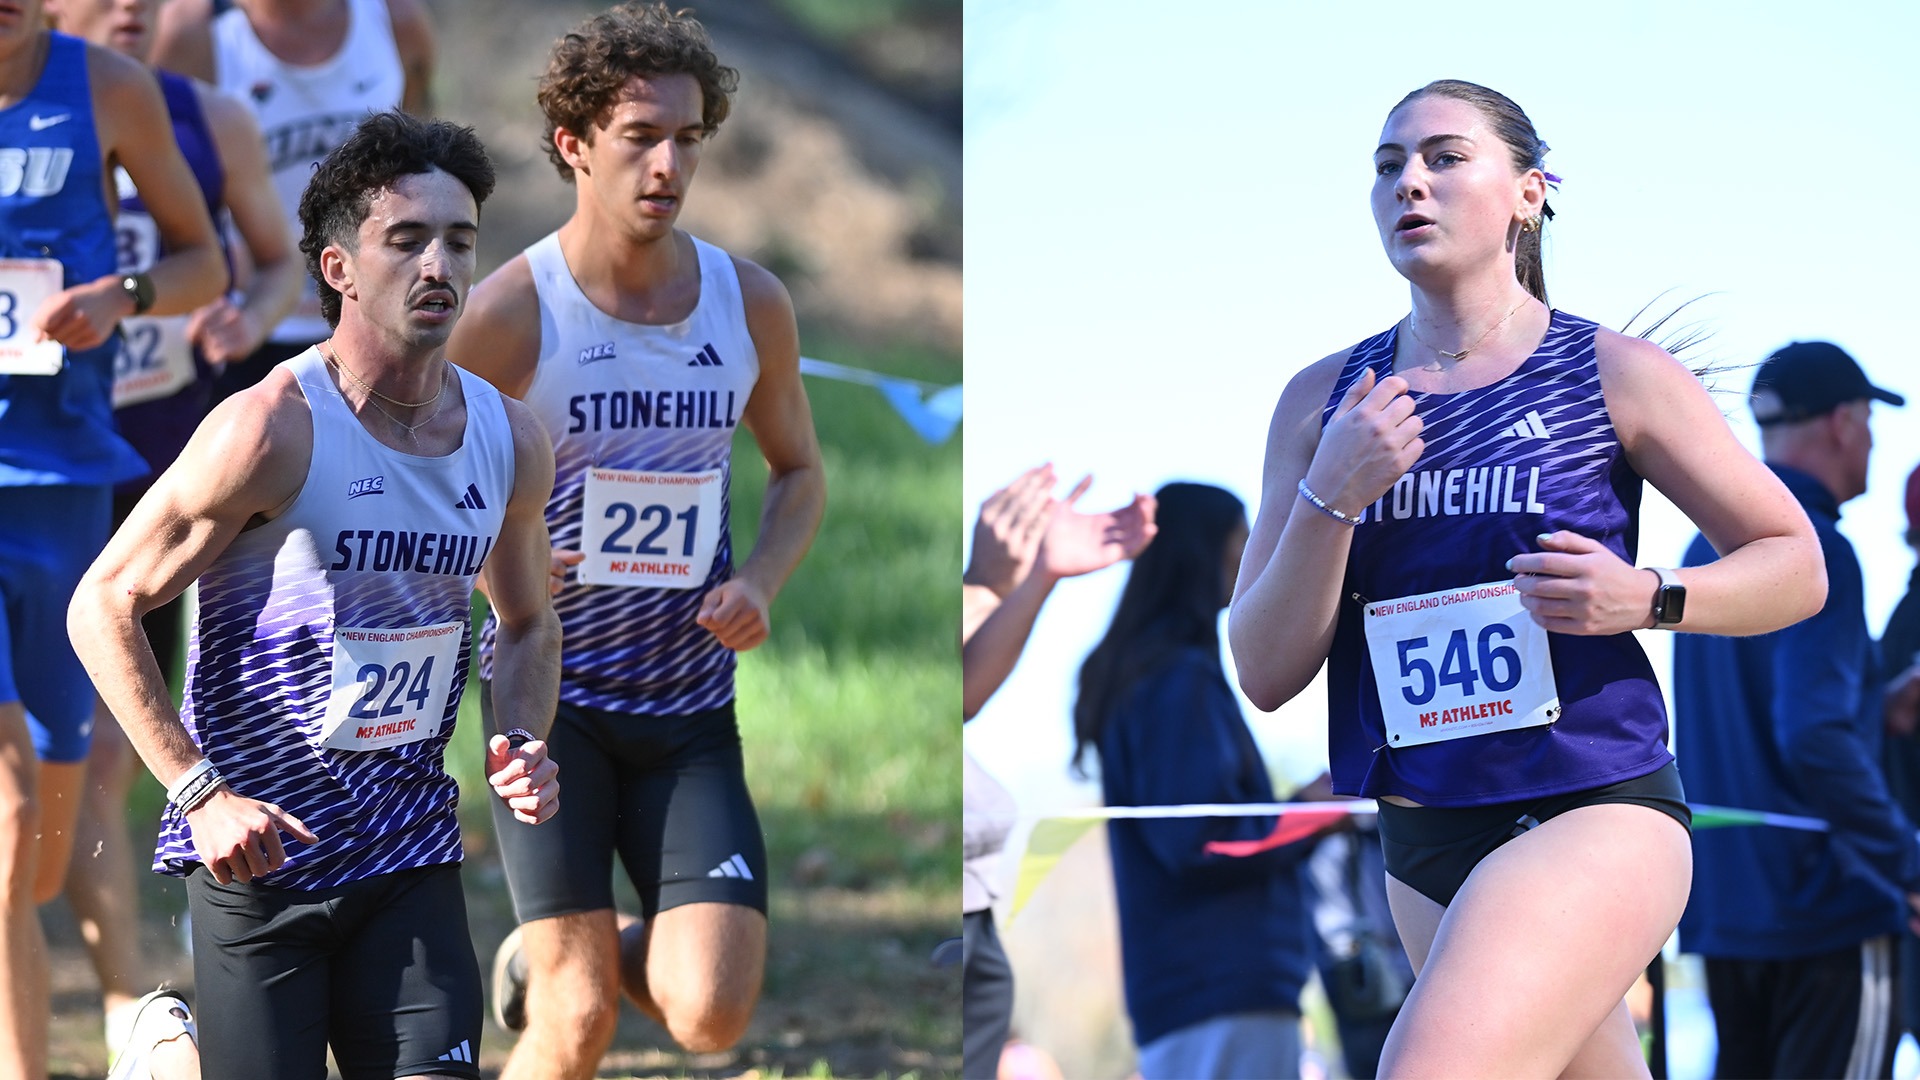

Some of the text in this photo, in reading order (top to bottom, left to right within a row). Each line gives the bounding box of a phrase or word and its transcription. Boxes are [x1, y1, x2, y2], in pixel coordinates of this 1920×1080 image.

[579, 341, 615, 364] NEC
[569, 390, 736, 434] STONEHILL
[348, 475, 384, 496] NEC
[597, 472, 615, 481] NEW
[618, 474, 656, 484] ENGLAND
[1358, 465, 1545, 525] ONEHILL
[600, 502, 699, 557] 221
[331, 530, 492, 576] STONEHILL
[631, 561, 690, 575] ATHLETIC
[1375, 584, 1517, 617] NEW ENGLAND CHAMPIONSHIP
[346, 625, 455, 643] NEW ENGLAND CHAMPIONSHIPS
[1396, 623, 1522, 706] 546
[347, 655, 435, 719] 224
[1441, 699, 1513, 725] ATHLETIC
[374, 718, 416, 738] ATHLETIC
